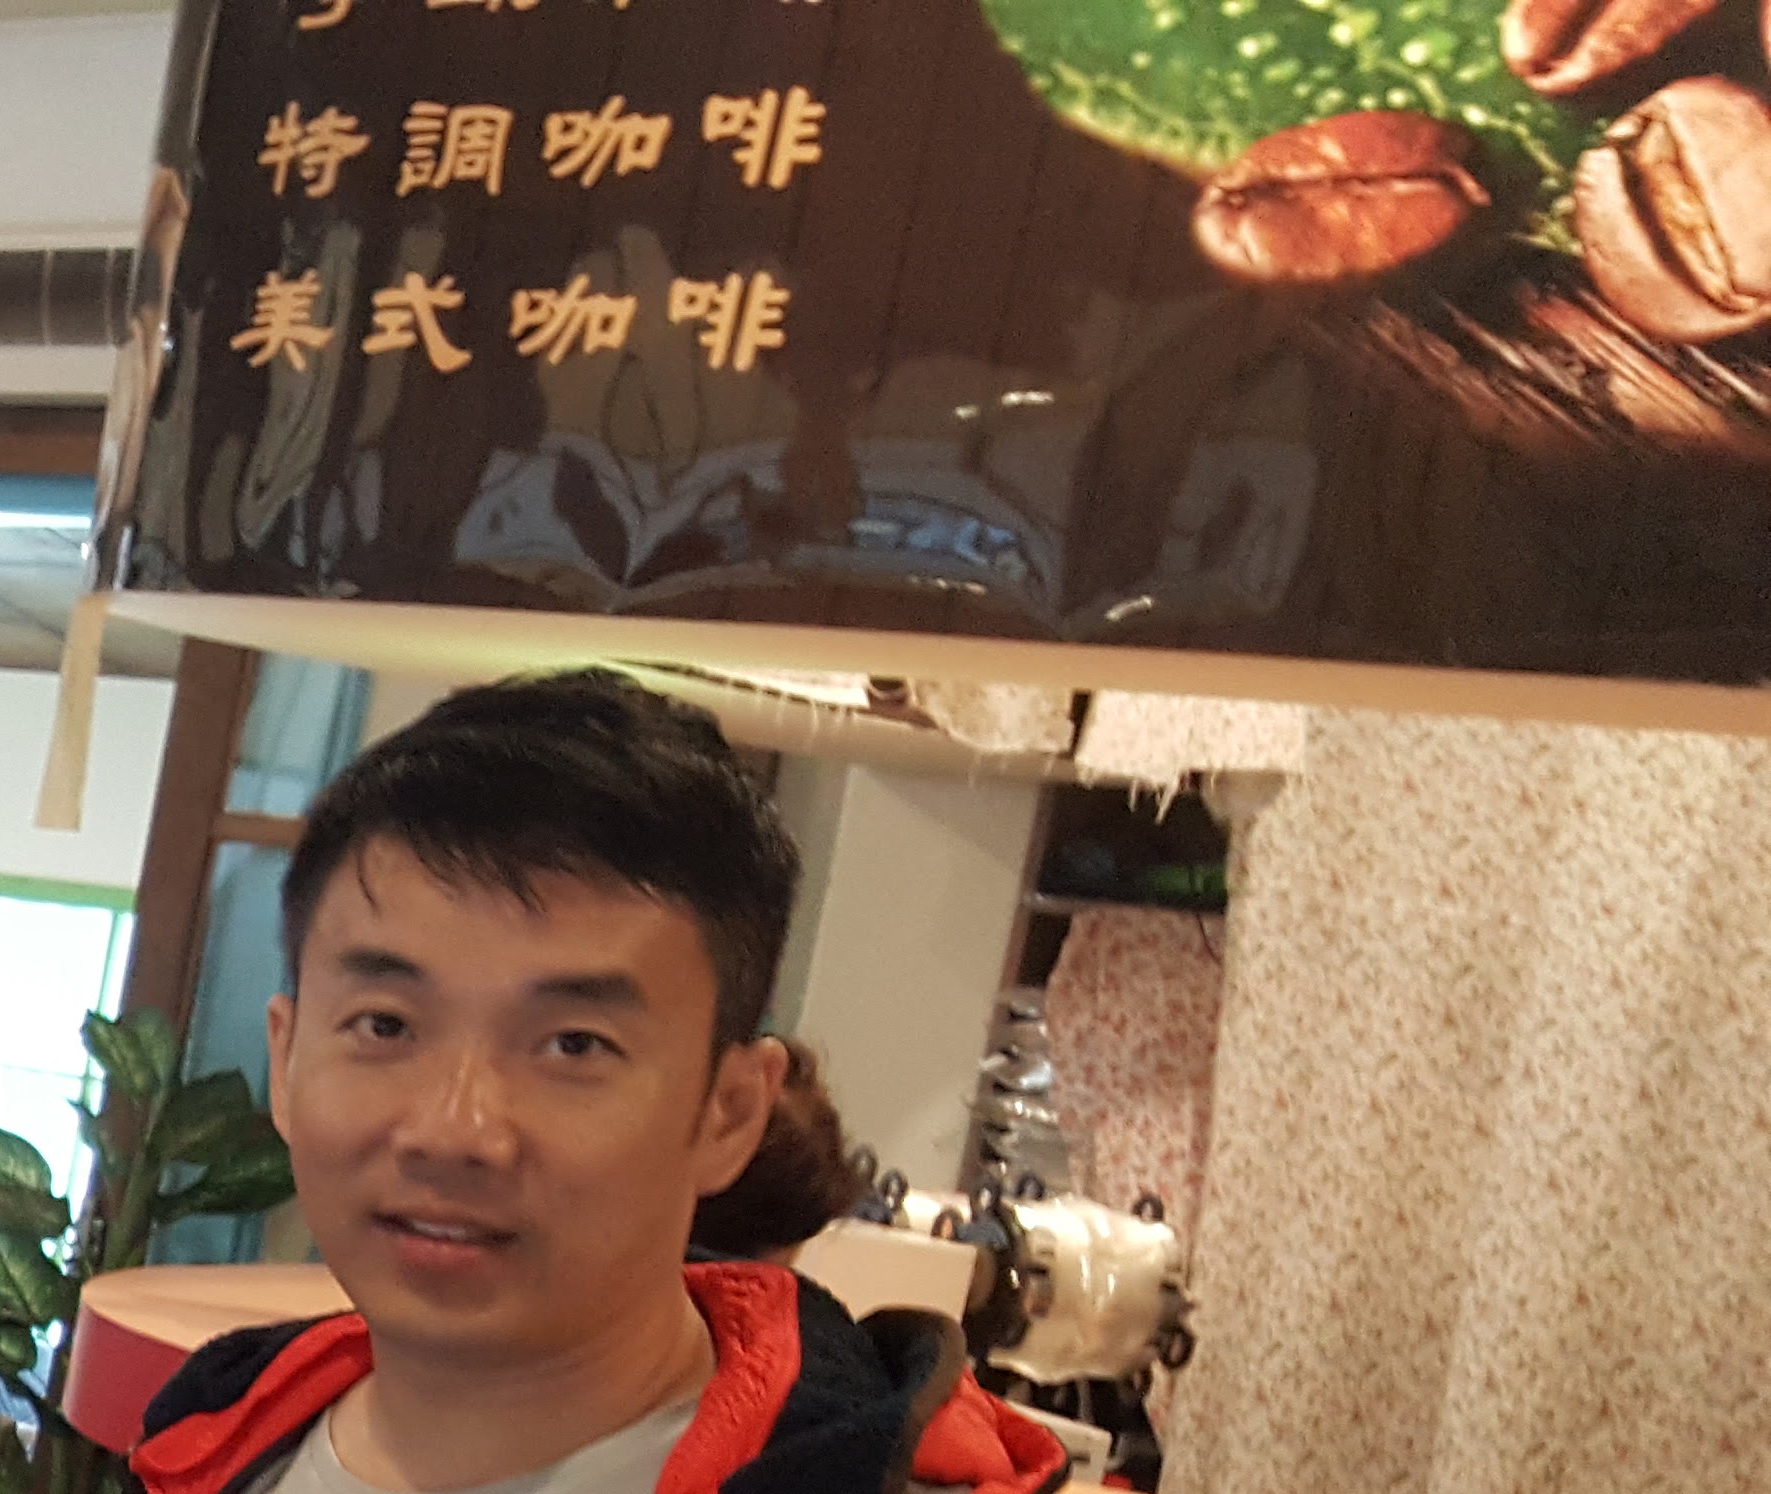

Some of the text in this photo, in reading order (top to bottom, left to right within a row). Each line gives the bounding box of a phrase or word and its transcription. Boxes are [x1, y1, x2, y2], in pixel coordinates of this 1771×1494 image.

[257, 85, 827, 198] 特調咖啡
[229, 269, 792, 373] 美式咖啡
